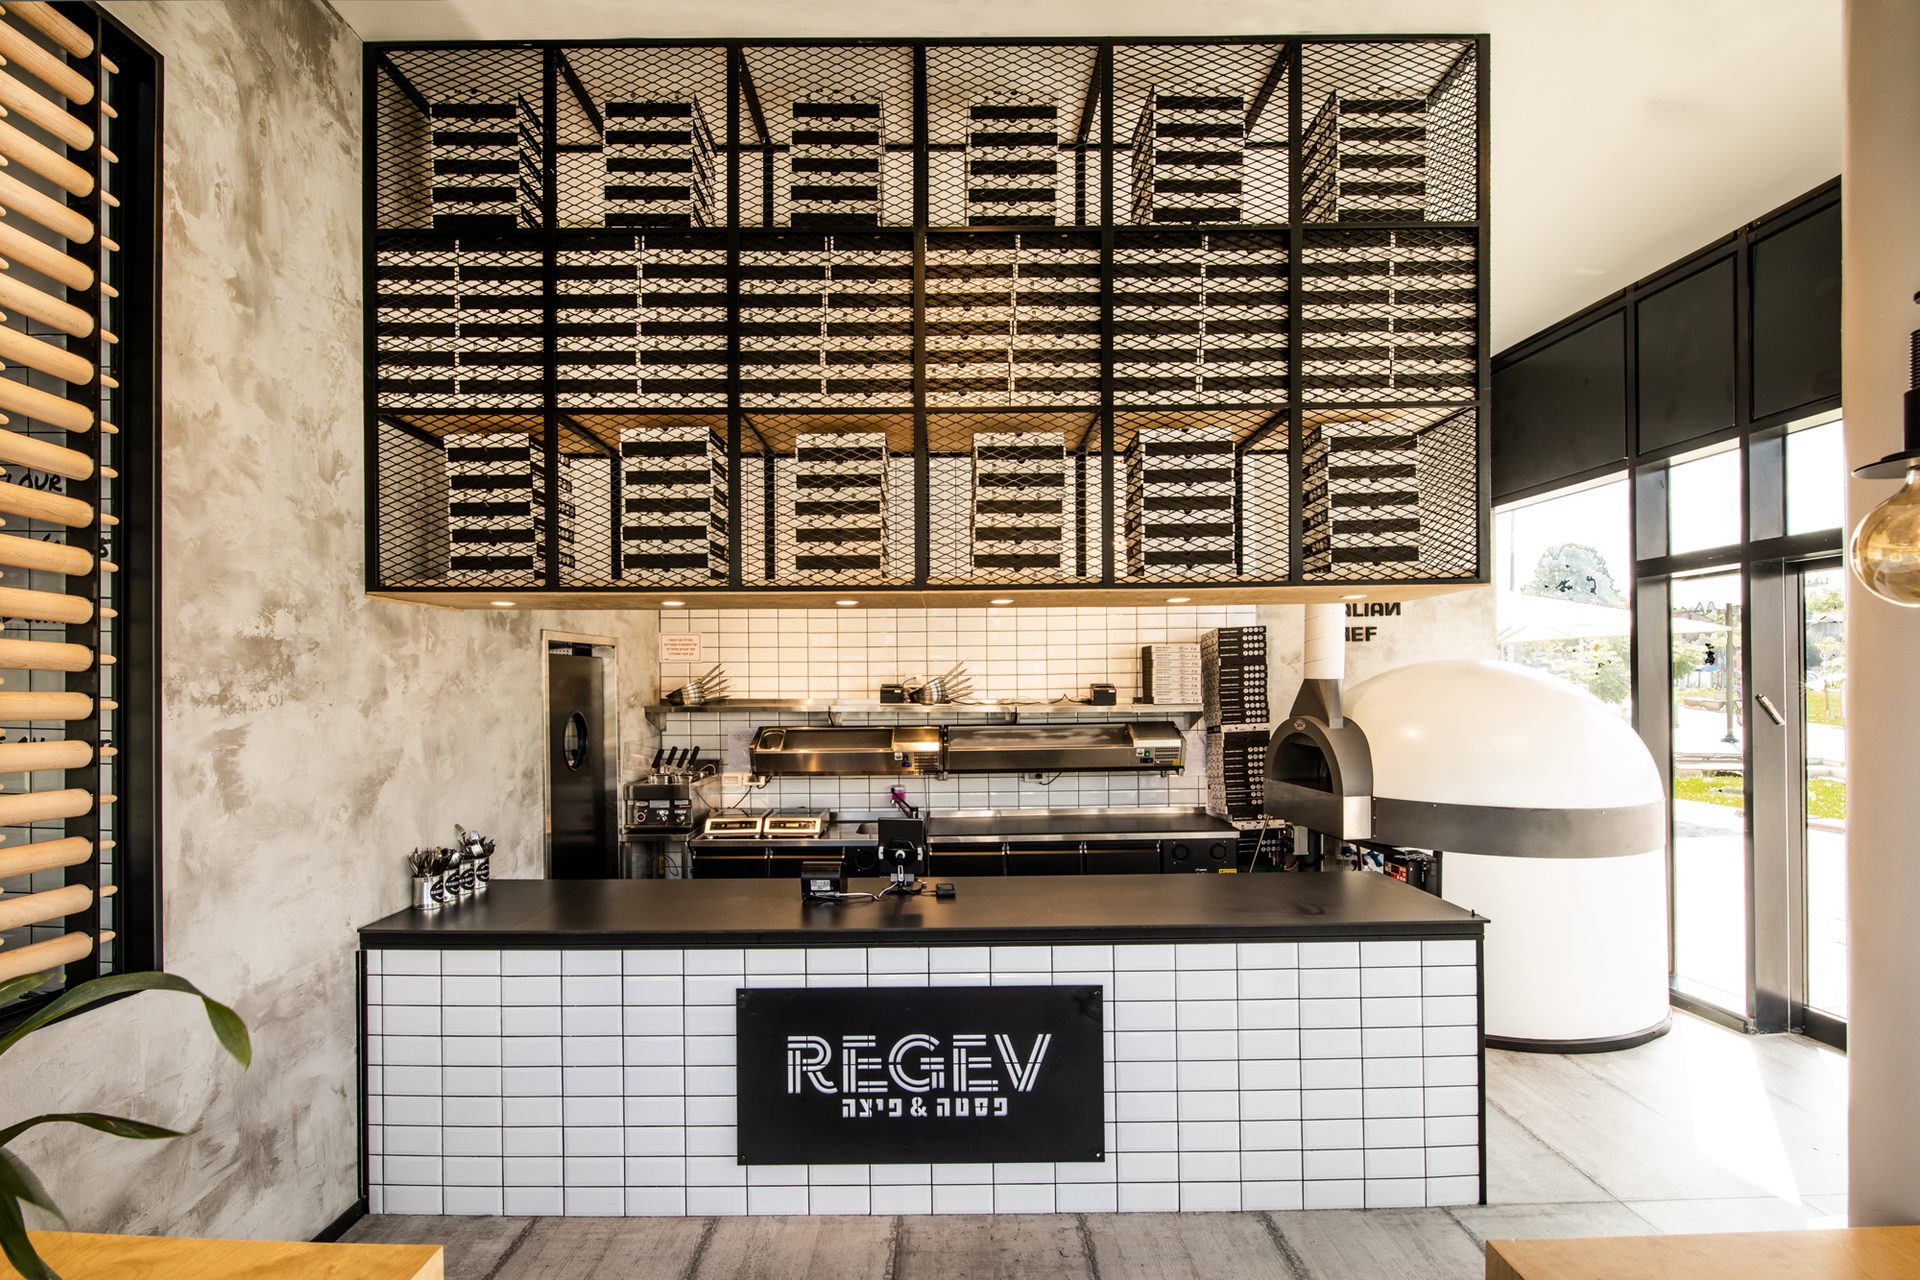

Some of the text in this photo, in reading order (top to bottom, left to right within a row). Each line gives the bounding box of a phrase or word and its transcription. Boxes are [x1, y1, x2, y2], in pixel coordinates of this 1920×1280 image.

[787, 1033, 1052, 1094] REGEV
[842, 1096, 1008, 1118] פסטה & פיצה
